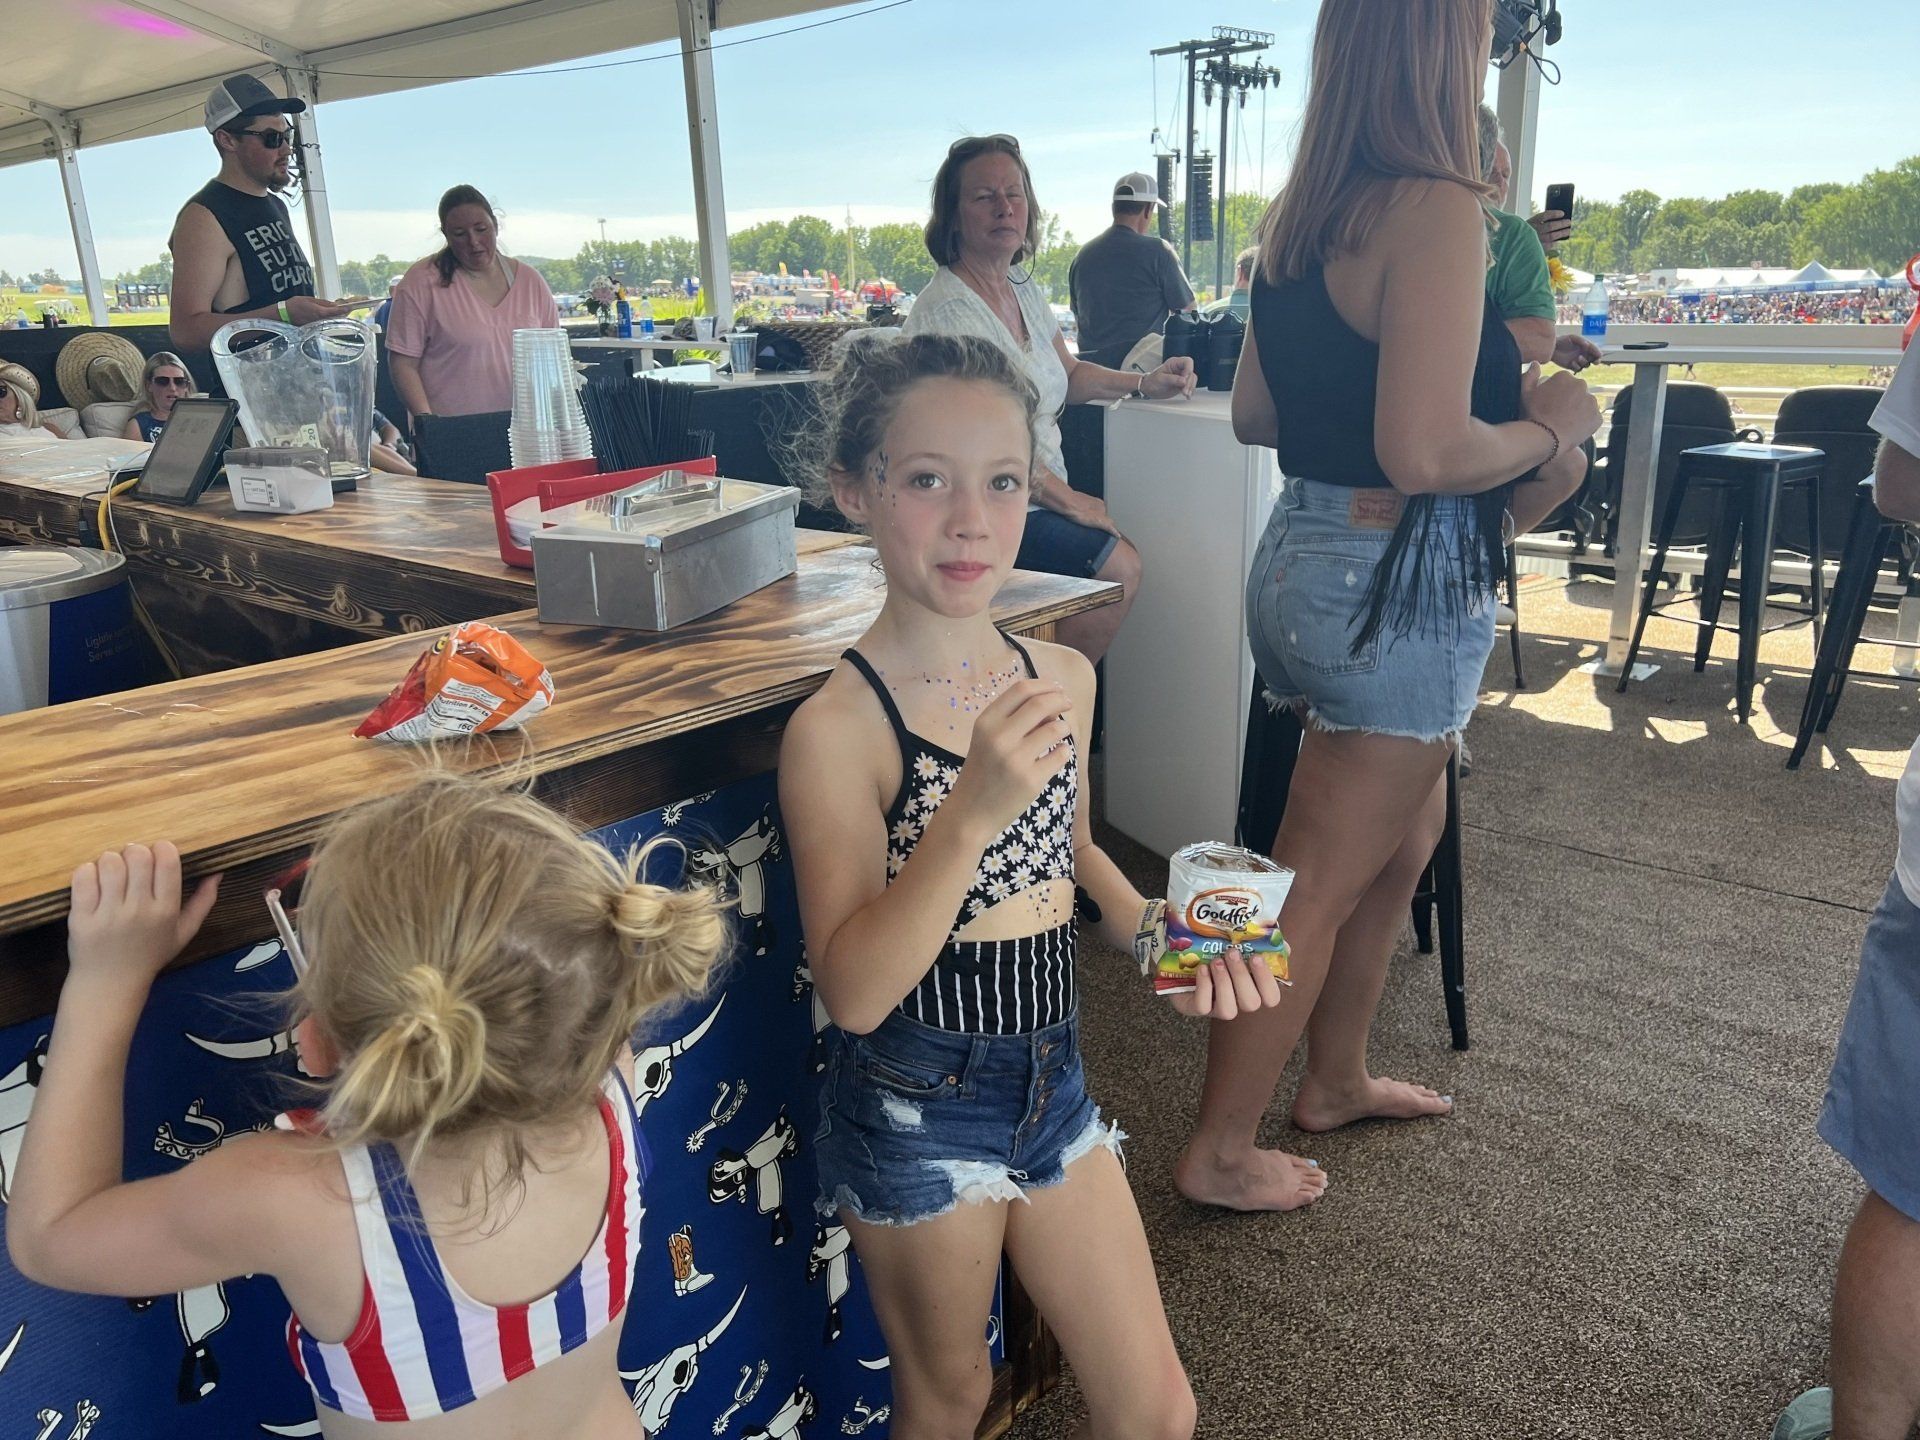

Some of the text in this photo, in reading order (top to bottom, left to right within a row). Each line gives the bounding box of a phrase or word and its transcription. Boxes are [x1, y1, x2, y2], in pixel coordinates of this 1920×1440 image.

[244, 220, 290, 252] ERIC
[307, 427, 316, 441] 20
[469, 704, 489, 717] Fats
[458, 722, 473, 731] 160
[1201, 941, 1254, 954] COLRS
